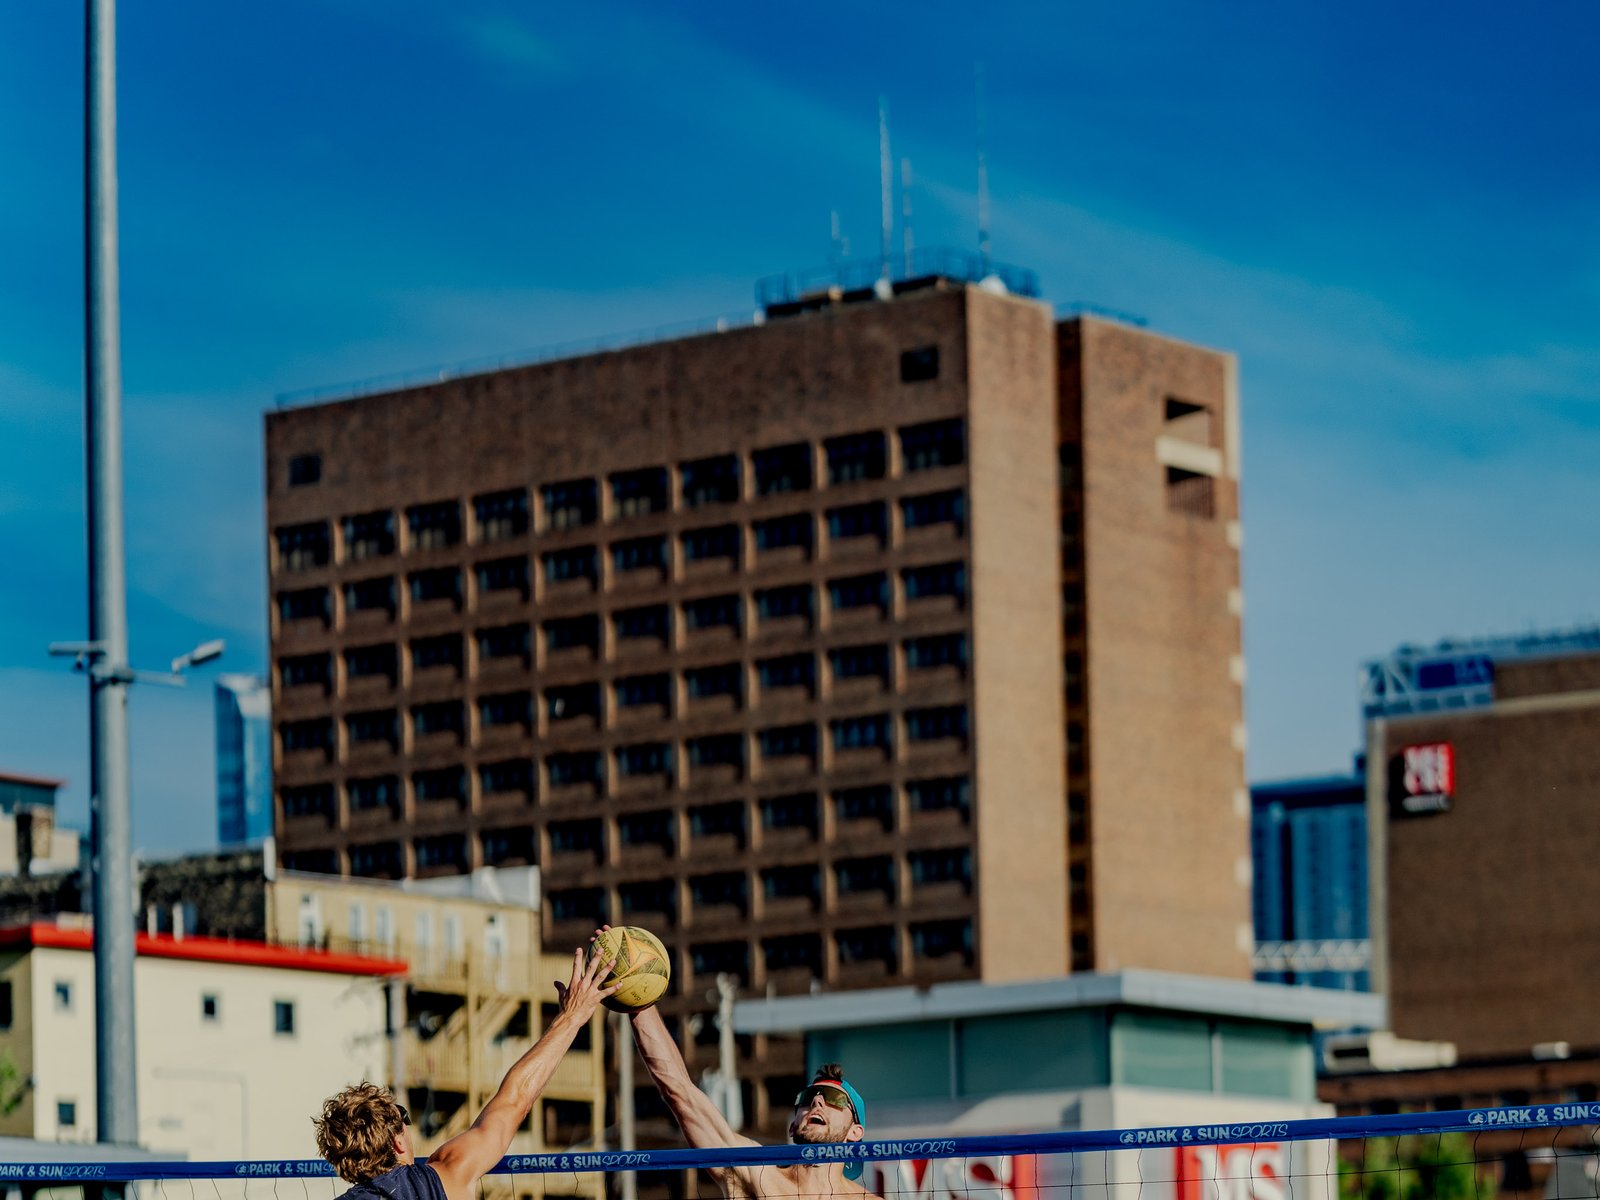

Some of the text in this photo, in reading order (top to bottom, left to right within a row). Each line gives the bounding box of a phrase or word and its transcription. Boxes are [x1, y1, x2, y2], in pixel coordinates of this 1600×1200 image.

[1487, 1109, 1531, 1125] PARK
[1536, 1108, 1548, 1122] &
[1138, 1129, 1178, 1143] PARK
[1182, 1128, 1193, 1141] &
[817, 1145, 855, 1158] PARK
[859, 1144, 869, 1157] &
[249, 1163, 280, 1175] PARK
[284, 1162, 293, 1174] &
[523, 1156, 556, 1169] PARK
[560, 1156, 570, 1169] &
[27, 1165, 36, 1177] &
